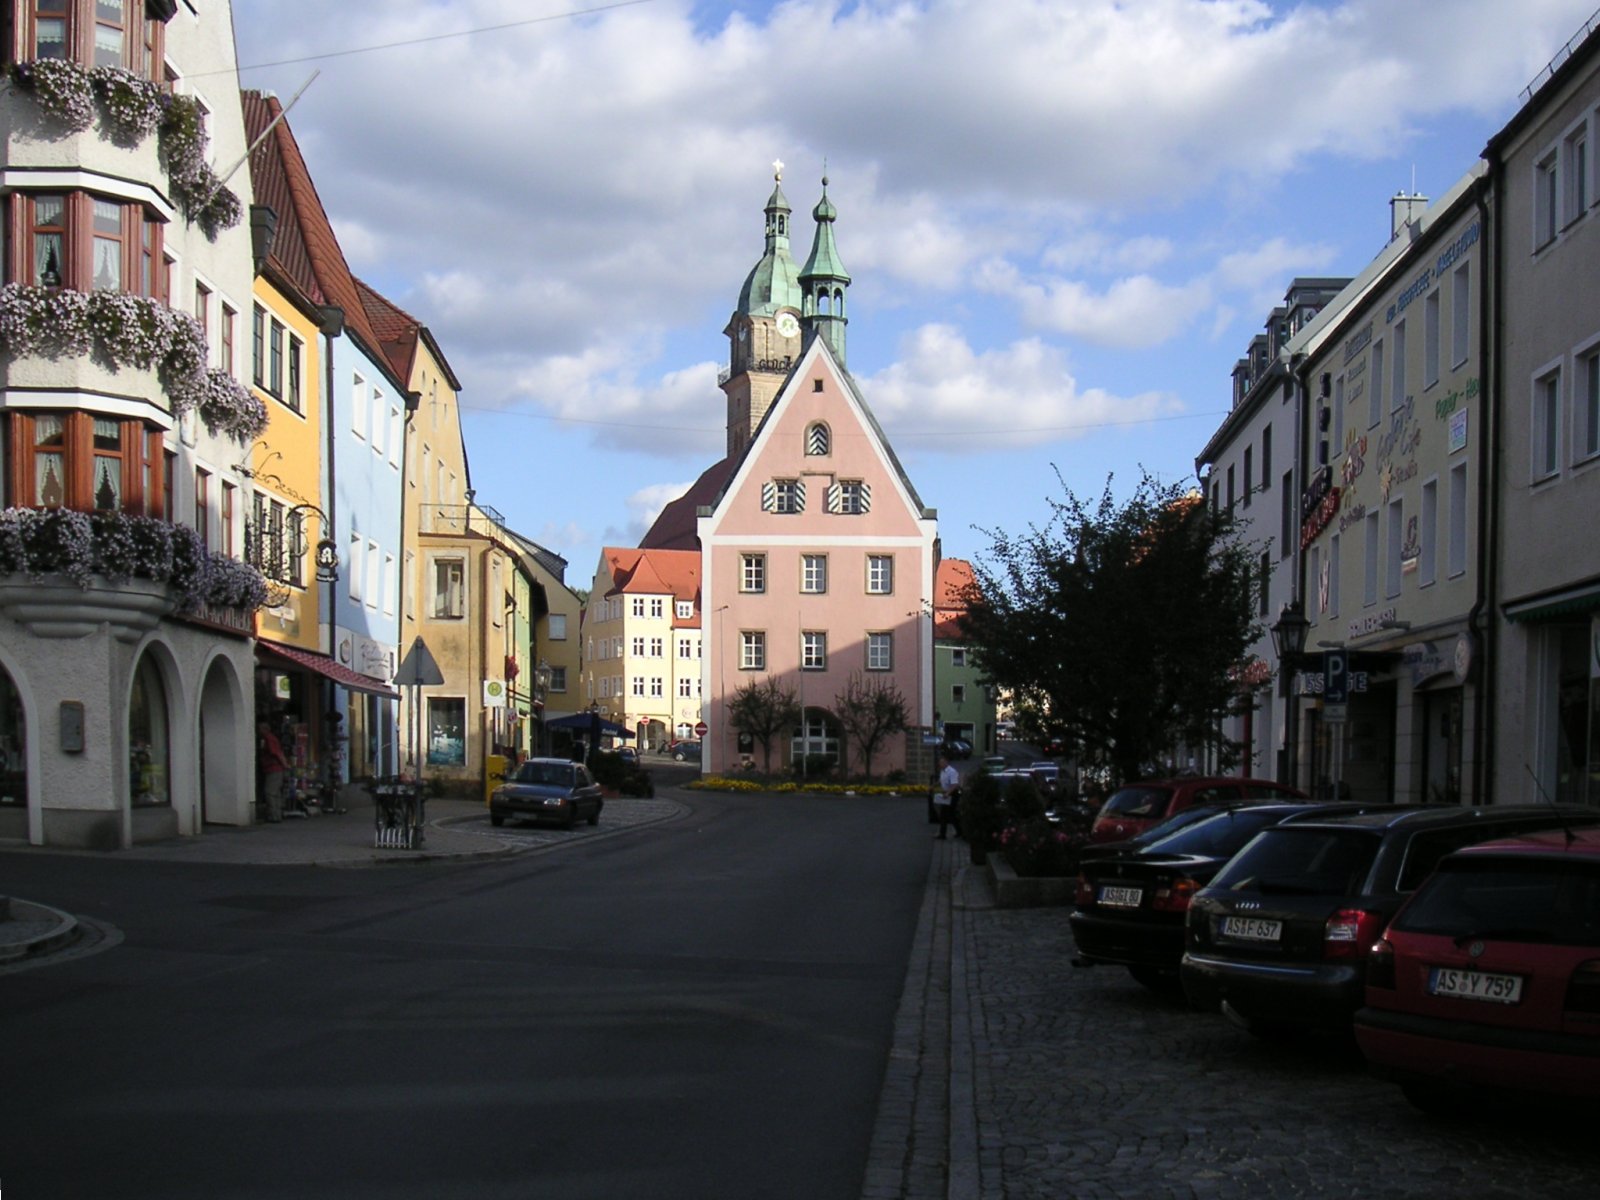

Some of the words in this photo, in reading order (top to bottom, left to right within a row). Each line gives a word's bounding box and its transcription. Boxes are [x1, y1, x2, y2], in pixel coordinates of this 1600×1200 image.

[1328, 655, 1343, 688] P
[1226, 917, 1240, 935] AS
[1246, 920, 1253, 935] F
[1256, 922, 1278, 938] 637
[1437, 971, 1457, 991] AS
[1470, 974, 1480, 993] Y
[1484, 976, 1515, 998] 759
